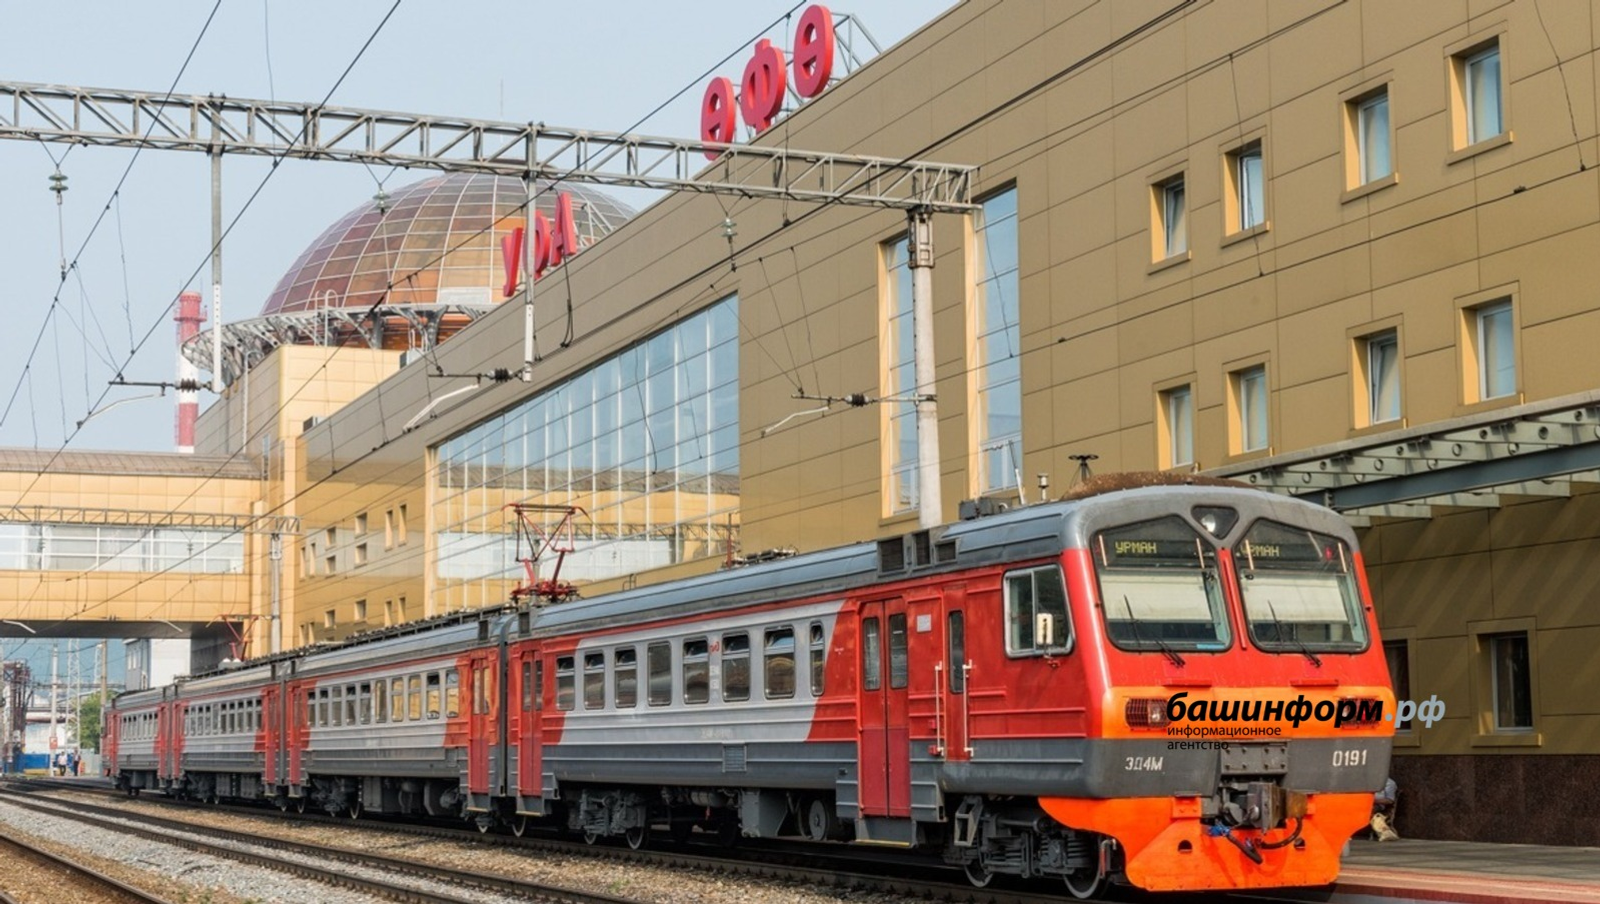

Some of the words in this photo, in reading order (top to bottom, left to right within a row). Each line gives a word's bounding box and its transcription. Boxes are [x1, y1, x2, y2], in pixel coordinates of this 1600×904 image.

[1115, 541, 1157, 554] УРМАН
[1124, 756, 1164, 771] ЭД4М
[1332, 749, 1368, 767] 0191
